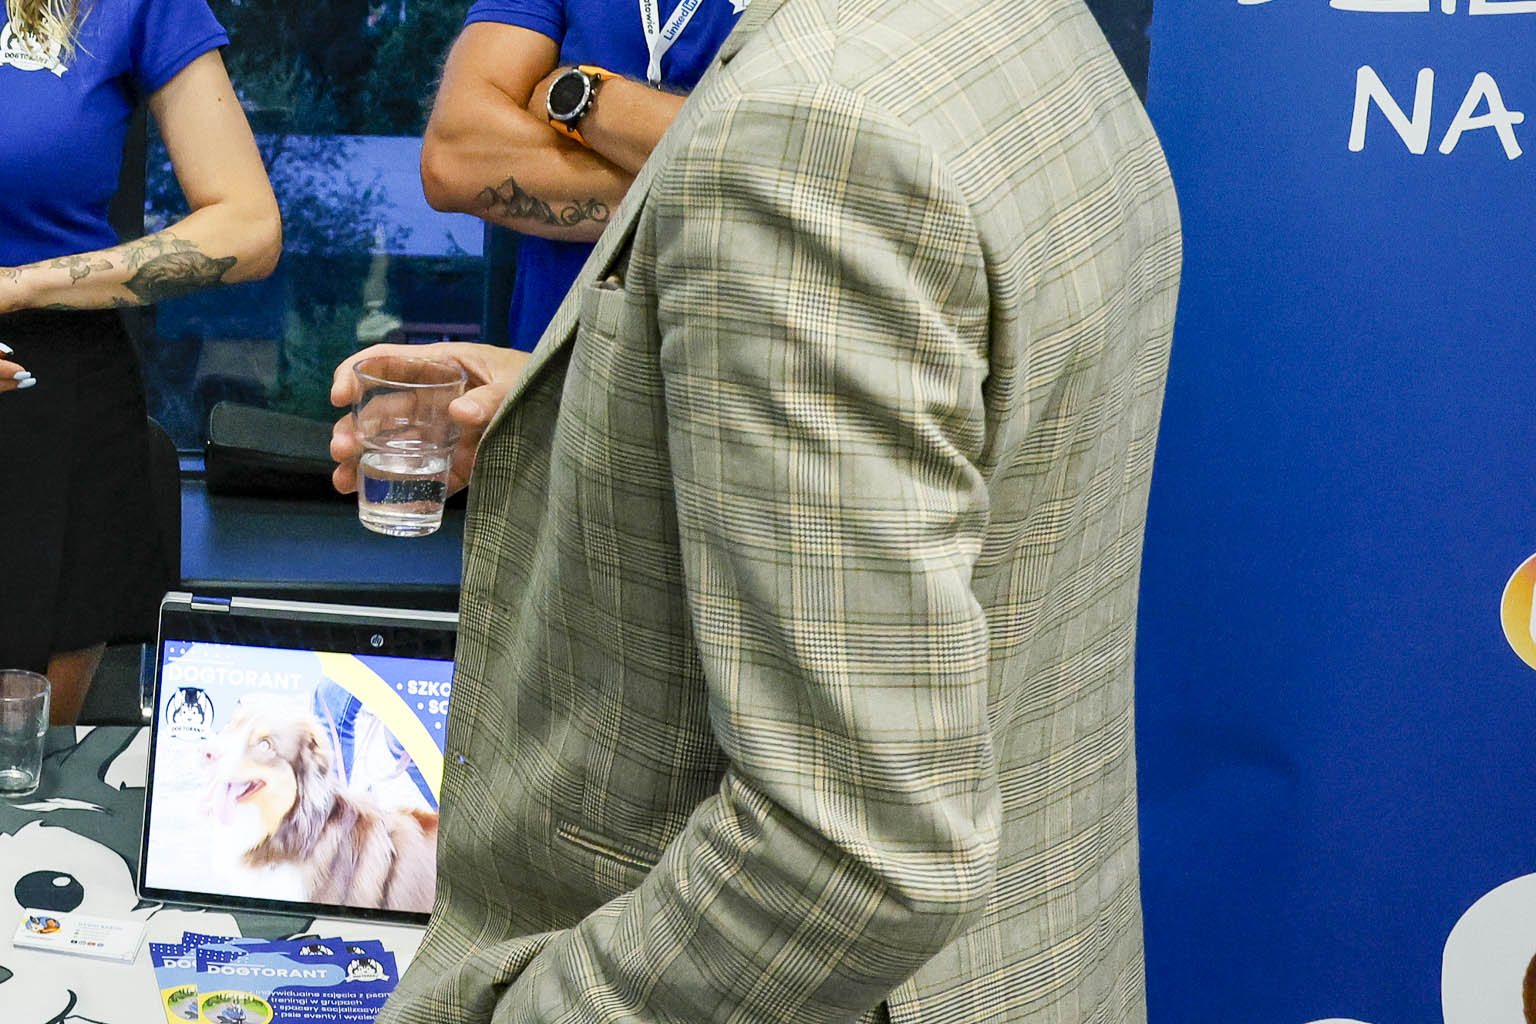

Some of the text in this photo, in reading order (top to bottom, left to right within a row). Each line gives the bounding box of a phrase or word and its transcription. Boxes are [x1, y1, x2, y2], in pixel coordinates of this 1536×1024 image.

[1348, 65, 1525, 160] NA
[169, 663, 302, 690] DOGTORANT
[407, 679, 451, 698] SZKO
[164, 959, 196, 969] DO
[207, 965, 327, 979] DOGTORANT
